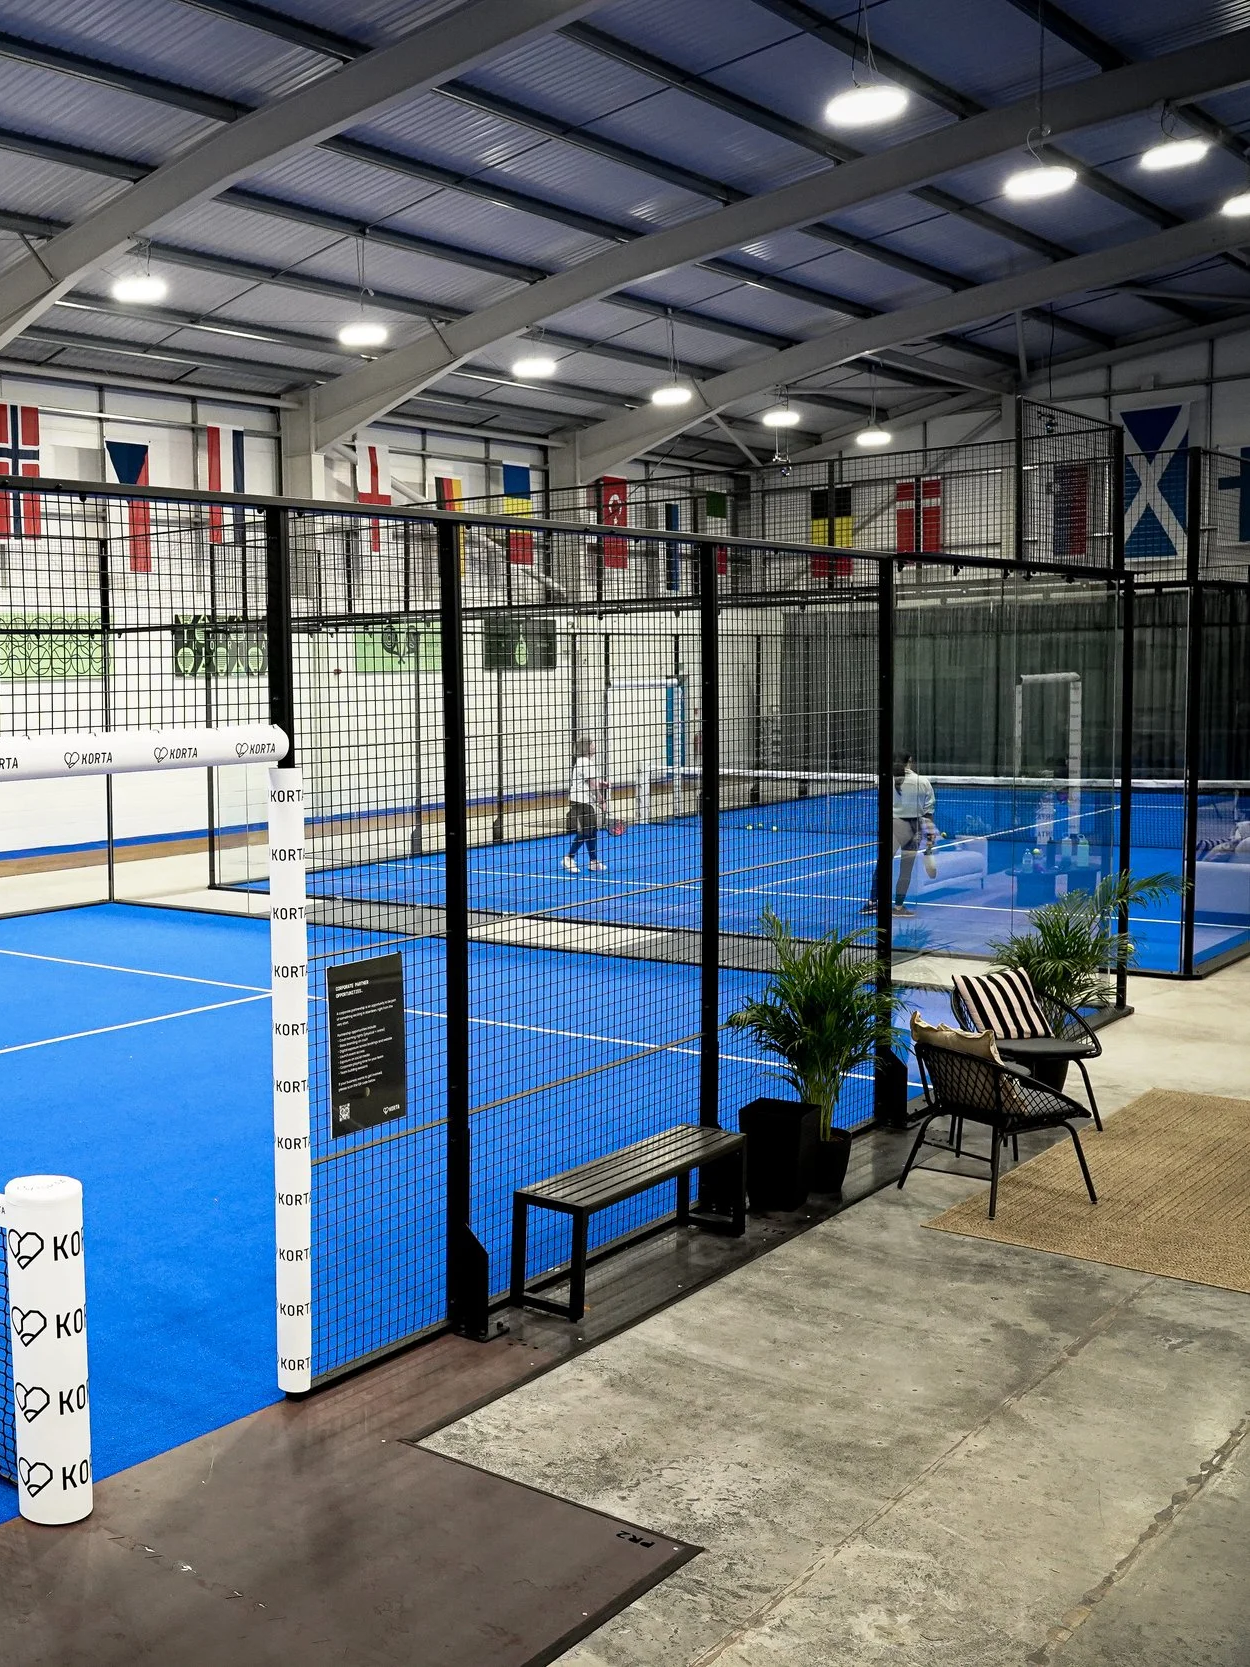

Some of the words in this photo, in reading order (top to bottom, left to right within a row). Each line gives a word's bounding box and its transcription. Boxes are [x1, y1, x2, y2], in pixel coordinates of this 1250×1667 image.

[81, 752, 113, 764] KORTA
[170, 747, 198, 759] KORTA
[250, 743, 276, 755] KORTA
